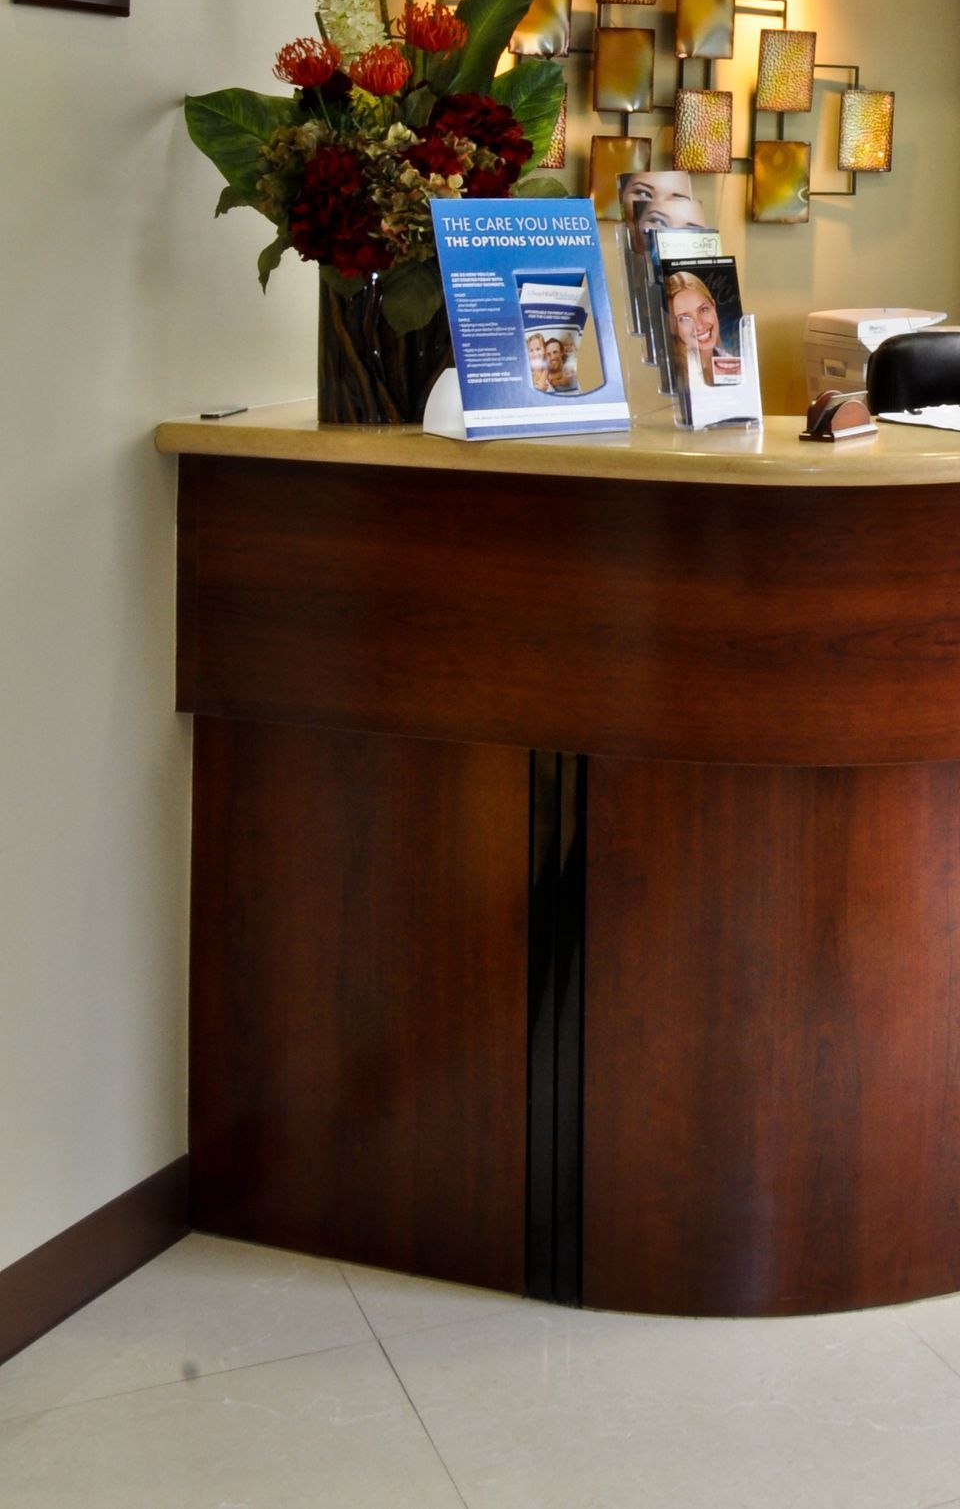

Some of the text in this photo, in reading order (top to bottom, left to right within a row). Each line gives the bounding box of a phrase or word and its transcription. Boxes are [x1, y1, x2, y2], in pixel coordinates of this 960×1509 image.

[441, 216, 593, 231] THE CARE YOU NEED.
[444, 235, 595, 247] THE OPTIONS YOU WANT.
